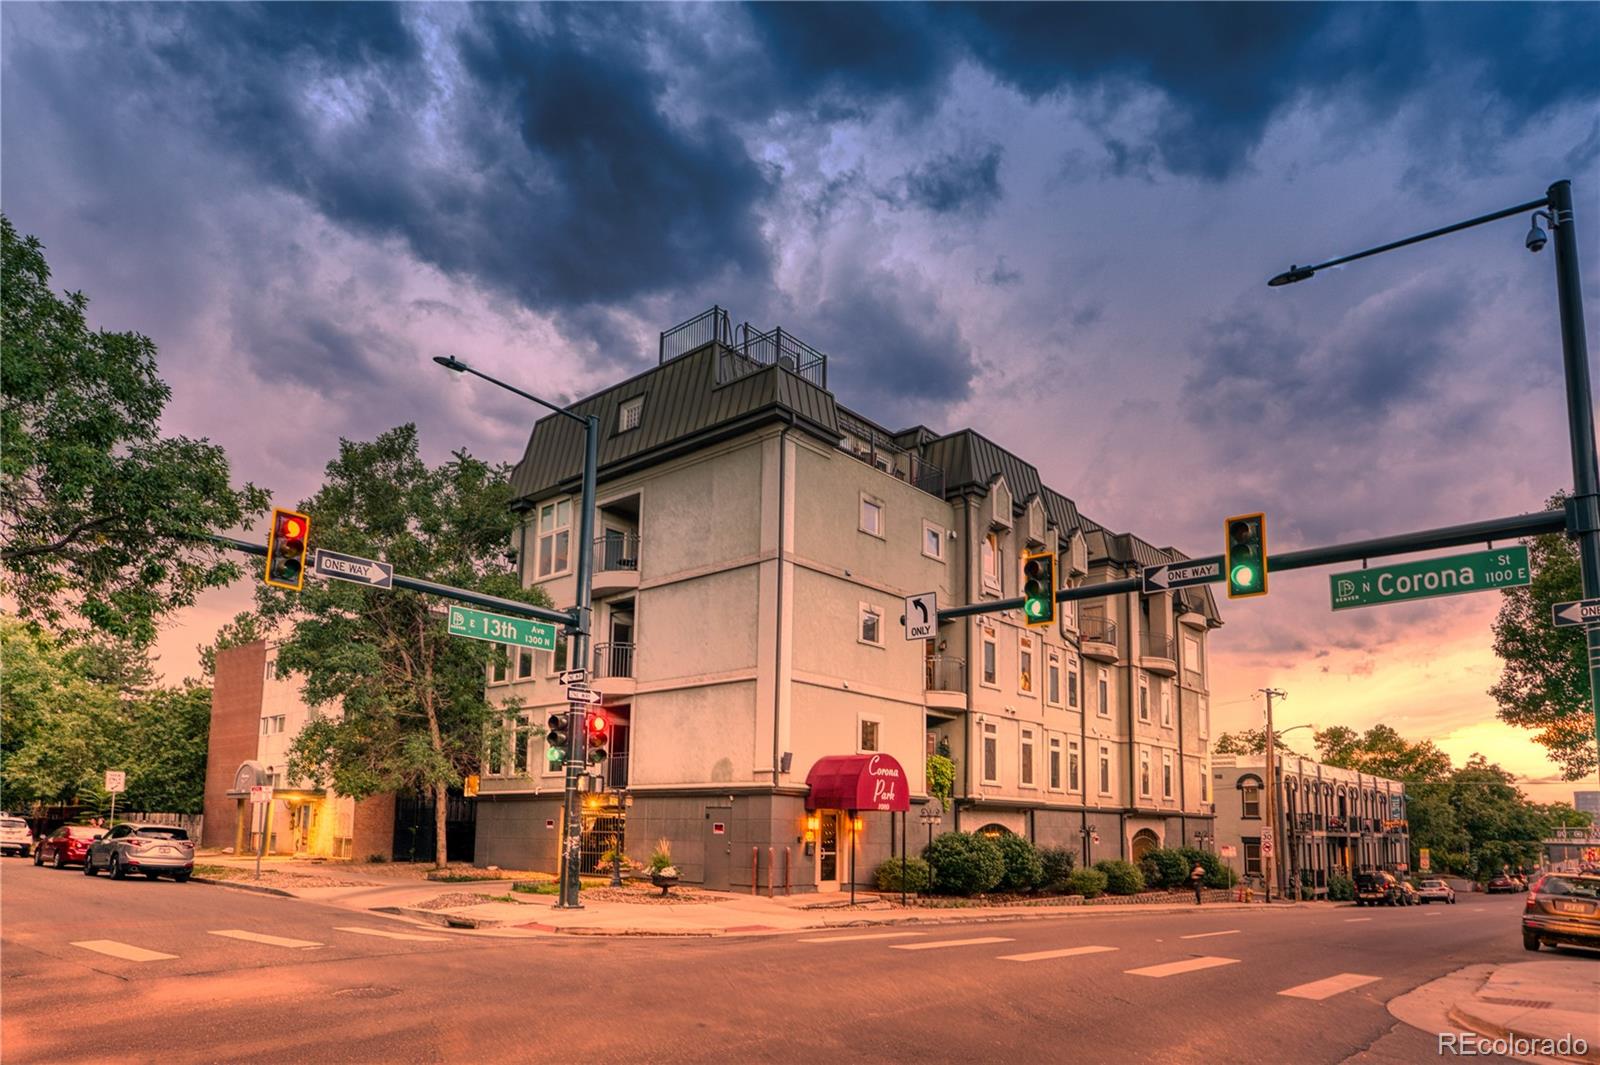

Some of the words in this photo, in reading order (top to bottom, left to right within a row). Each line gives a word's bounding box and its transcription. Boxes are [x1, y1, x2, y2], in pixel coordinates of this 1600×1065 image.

[324, 559, 346, 572] ONE
[349, 563, 370, 576] WAY
[1497, 555, 1511, 566] St
[1167, 569, 1188, 581] ONE
[1192, 566, 1213, 577] WAY
[1362, 581, 1370, 593] N
[1377, 566, 1475, 596] Corona
[1485, 569, 1513, 583] 1100
[1518, 567, 1526, 579] E
[469, 619, 476, 628] E
[482, 617, 518, 640] 13th
[530, 626, 545, 635] Ave
[911, 625, 931, 637] ONLY
[525, 635, 543, 645] 1300
[868, 754, 900, 777] Corona
[873, 778, 896, 803] Park
